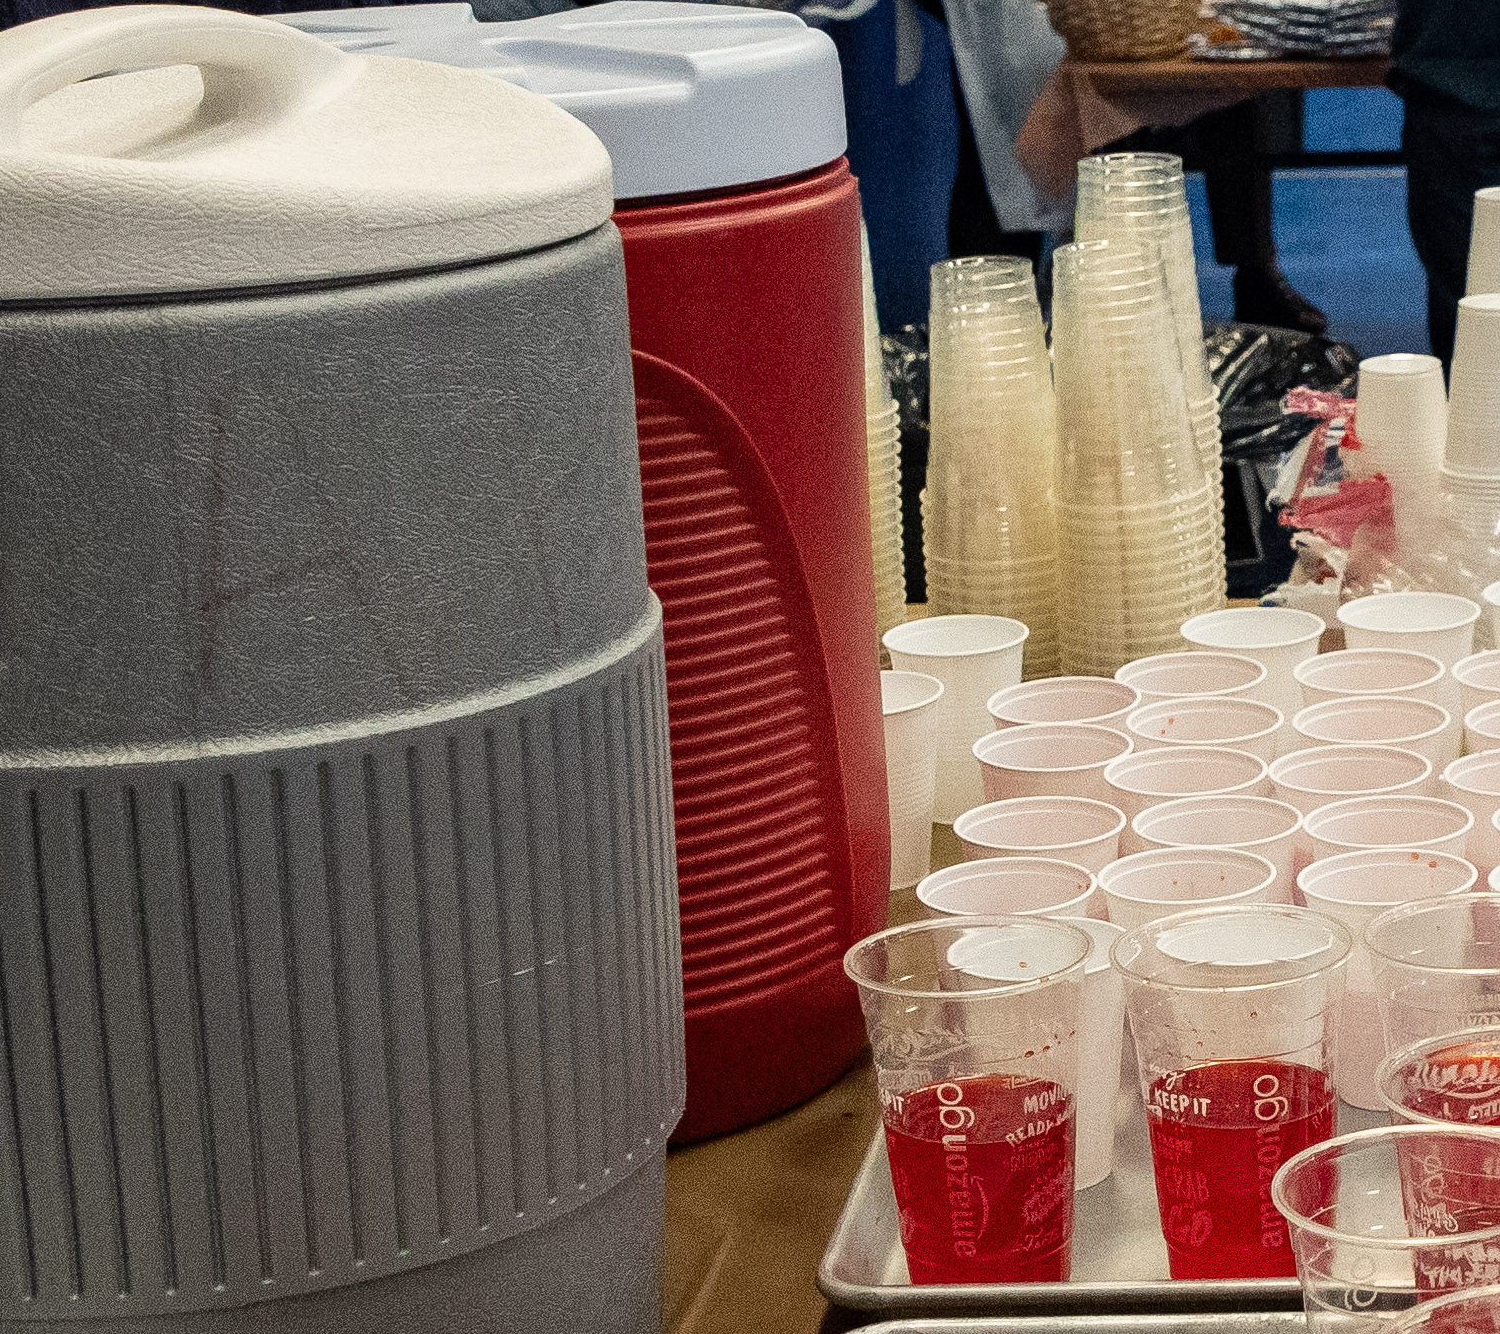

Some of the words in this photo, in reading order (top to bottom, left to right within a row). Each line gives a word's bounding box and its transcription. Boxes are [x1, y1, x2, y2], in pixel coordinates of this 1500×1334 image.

[935, 1080, 977, 1130] go
[1153, 1087, 1191, 1114] KEEP
[1192, 1096, 1212, 1118] IT
[1252, 1073, 1289, 1121] go
